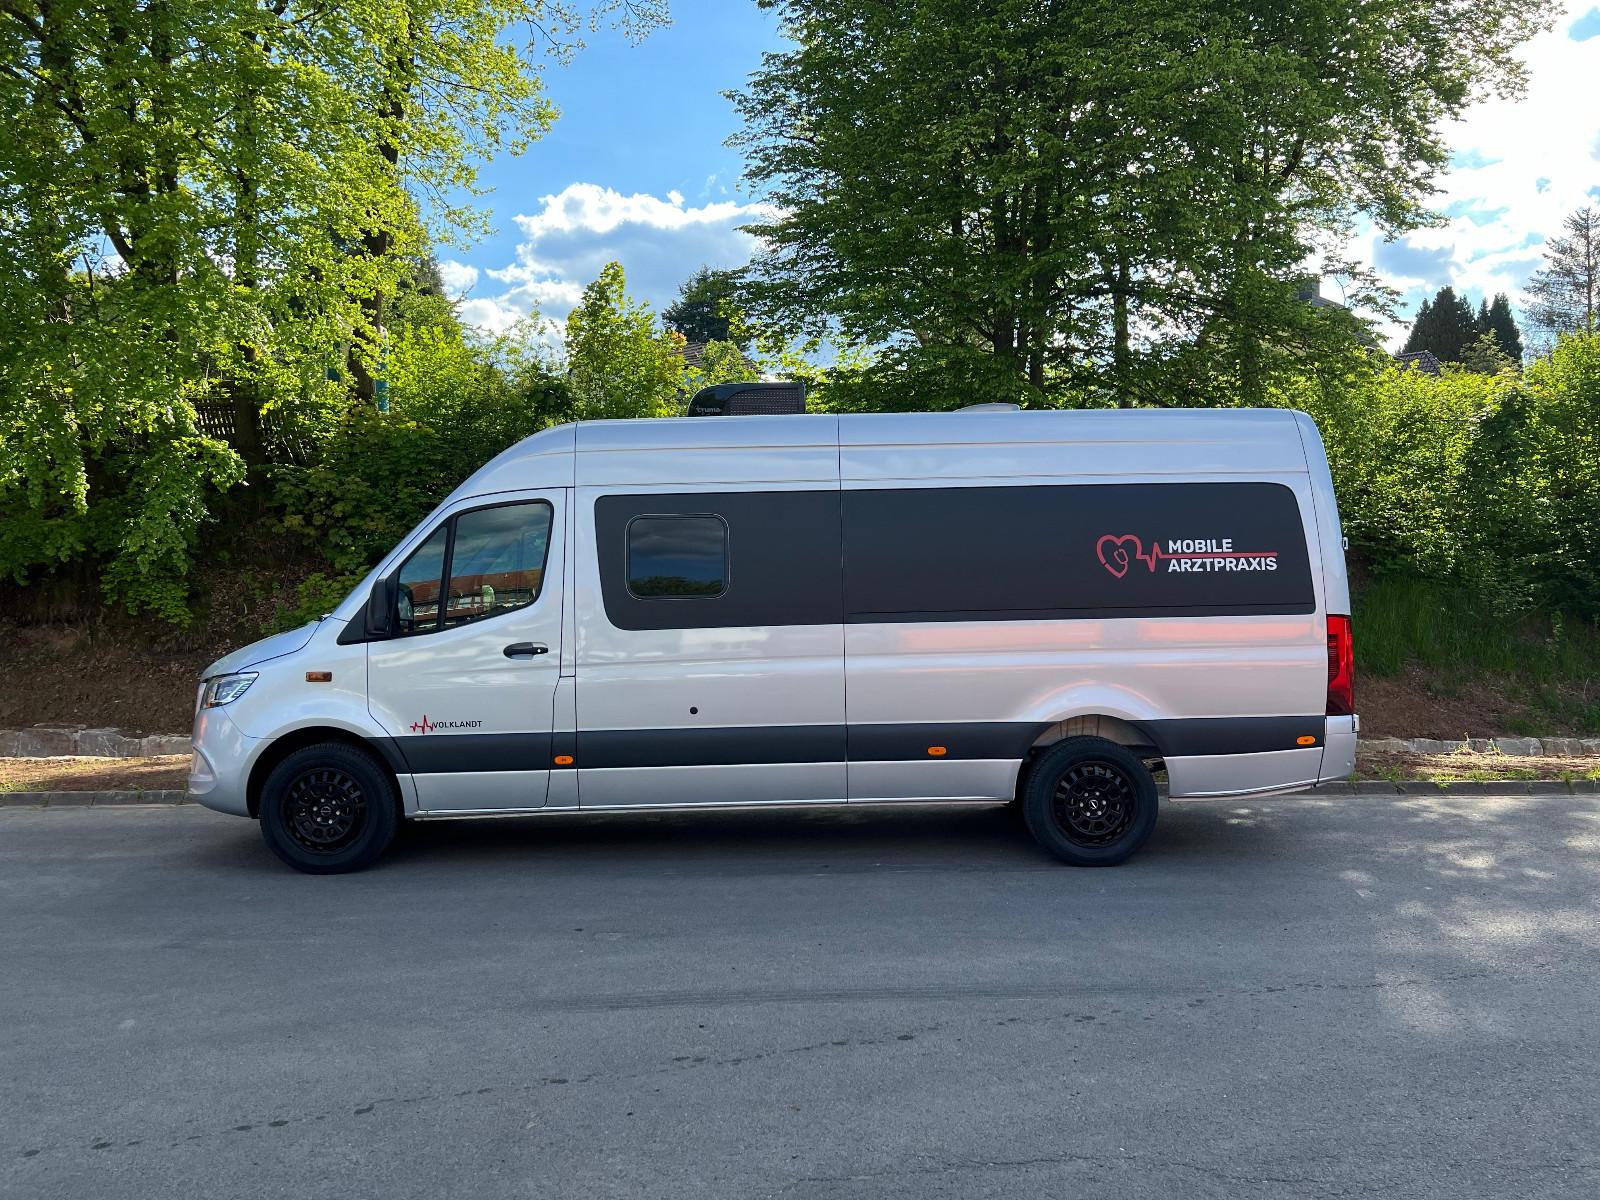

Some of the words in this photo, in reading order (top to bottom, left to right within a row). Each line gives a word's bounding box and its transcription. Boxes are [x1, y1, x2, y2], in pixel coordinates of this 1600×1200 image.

[1168, 538, 1233, 553] MOBILE
[1168, 557, 1278, 573] ARZTPRAXIS
[432, 720, 482, 729] VOLKLANDT
